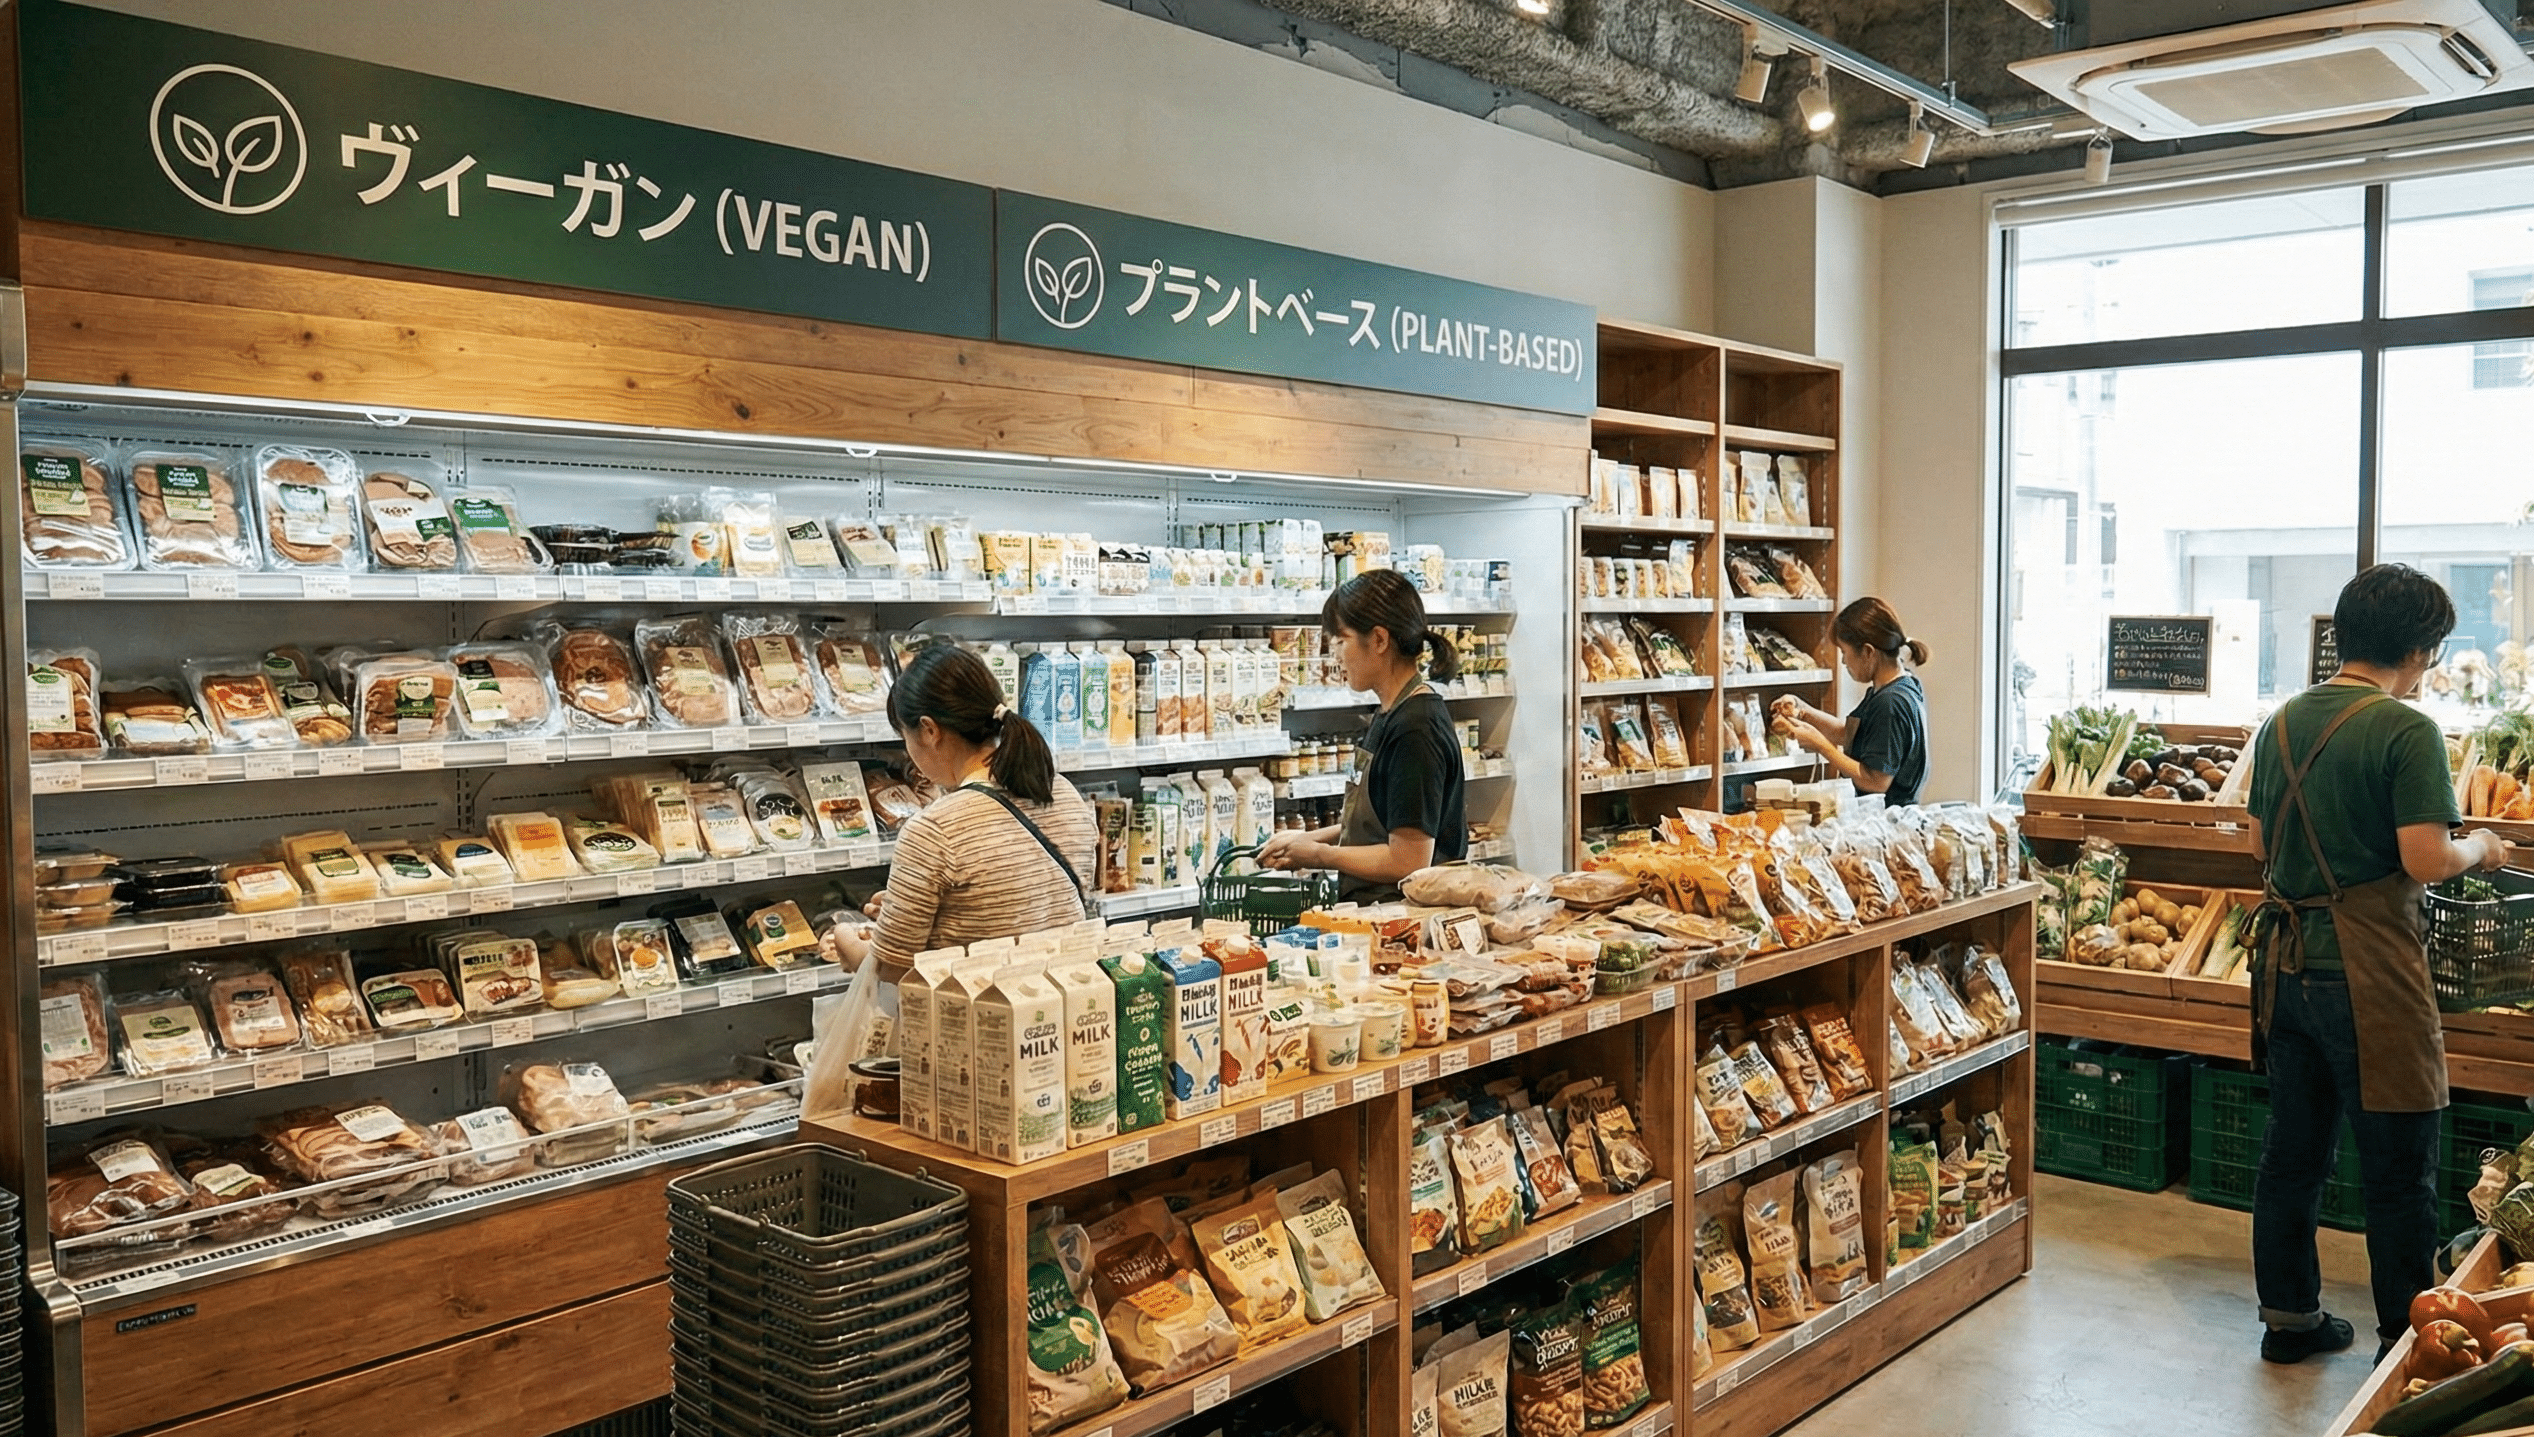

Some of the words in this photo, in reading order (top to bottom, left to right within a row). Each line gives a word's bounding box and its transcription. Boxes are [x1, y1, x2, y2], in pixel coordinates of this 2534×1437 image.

[340, 121, 697, 242] ヴィーガン
[715, 187, 931, 283] (VEGAN)
[1119, 258, 1382, 351] プラントベース
[1390, 305, 1584, 383] (PLANT-BASED)
[1019, 1036, 1060, 1060] MILK
[1072, 1024, 1111, 1046] MILK
